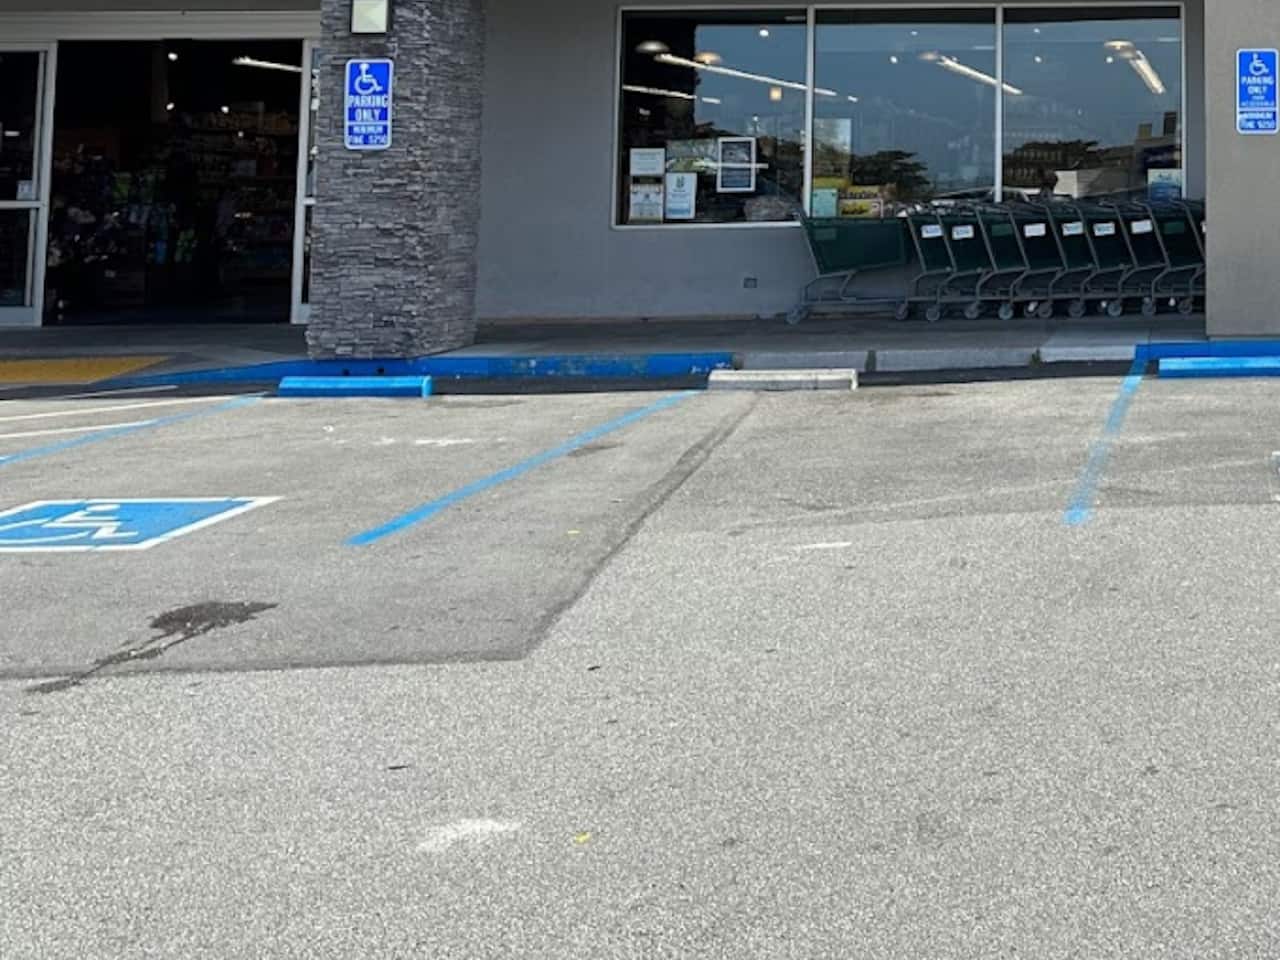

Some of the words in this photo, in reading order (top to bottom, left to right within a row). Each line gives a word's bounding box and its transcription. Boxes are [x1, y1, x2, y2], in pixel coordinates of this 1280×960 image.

[1241, 76, 1275, 86] PARKING
[1247, 86, 1268, 95] ONLY
[347, 95, 388, 108] PARKING
[354, 109, 380, 121] ONLY
